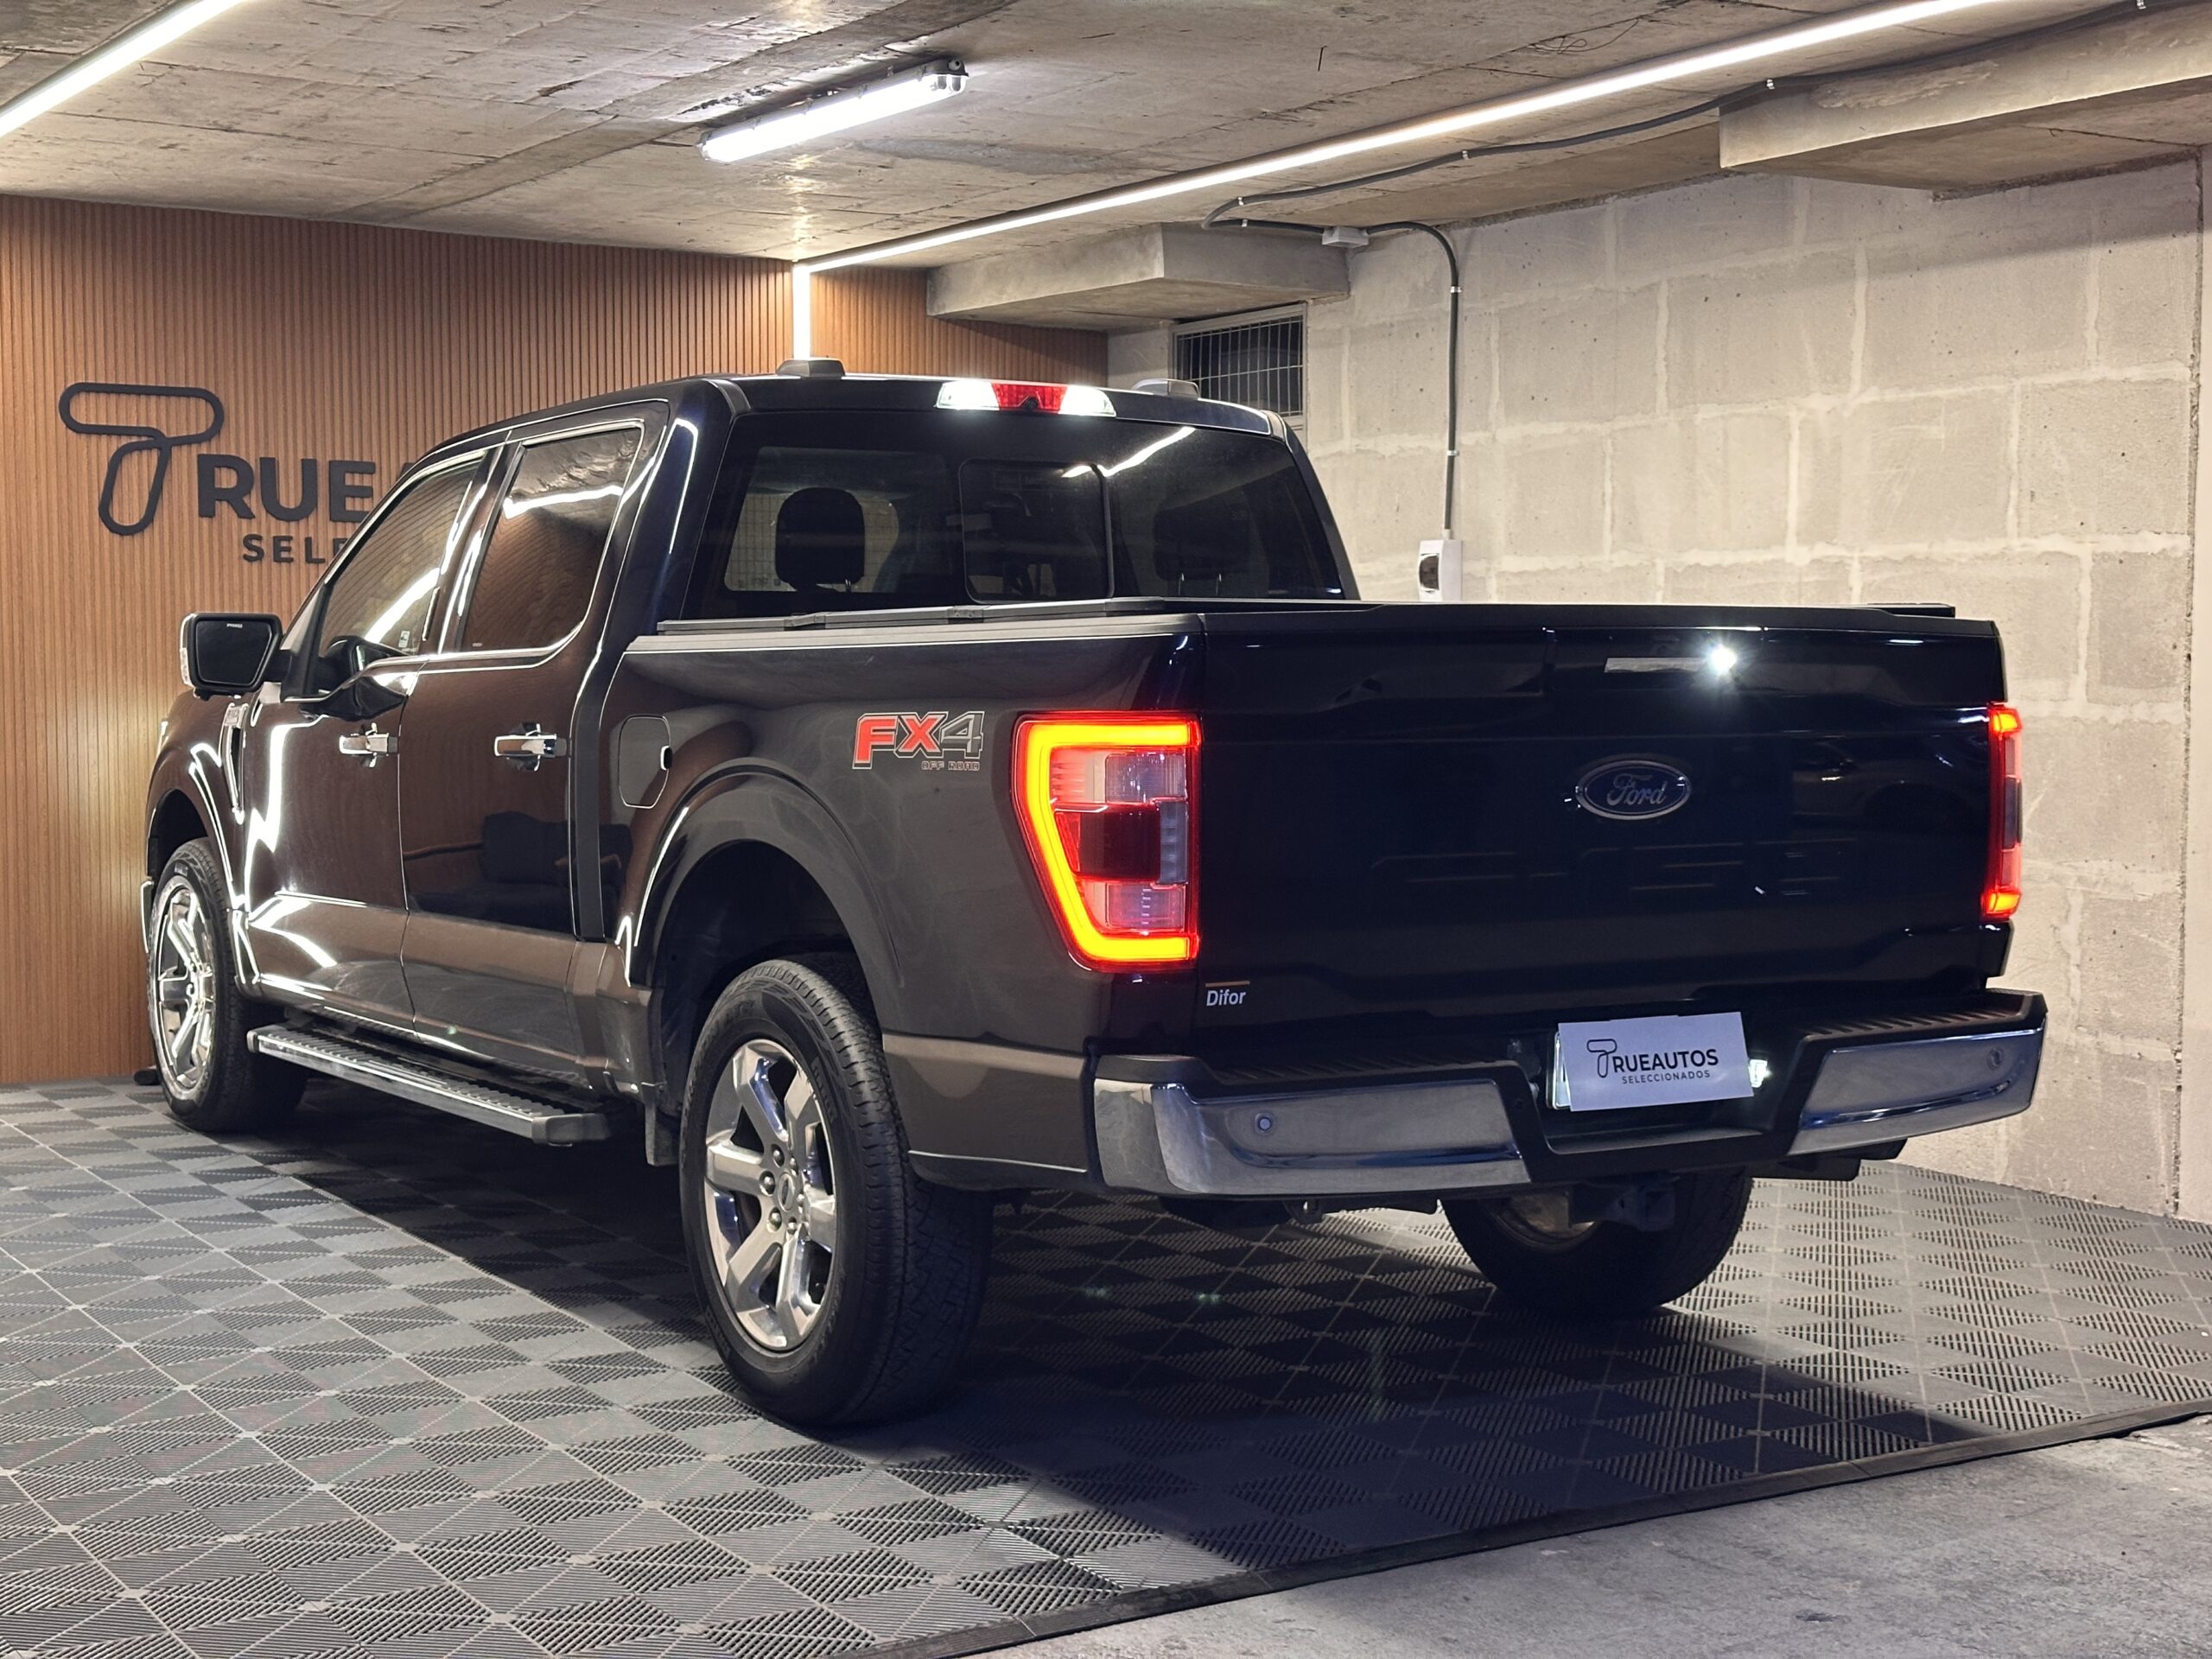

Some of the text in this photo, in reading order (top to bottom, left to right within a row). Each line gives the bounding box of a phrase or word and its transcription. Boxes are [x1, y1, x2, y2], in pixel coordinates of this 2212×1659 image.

[59, 381, 415, 536] TRUE
[852, 711, 984, 769] FX4
[921, 760, 980, 771] OFF ROAD
[1606, 772, 1668, 805] Ford
[1206, 989, 1246, 1006] Difor
[1622, 1070, 1711, 1084] SELECCIONADOS
